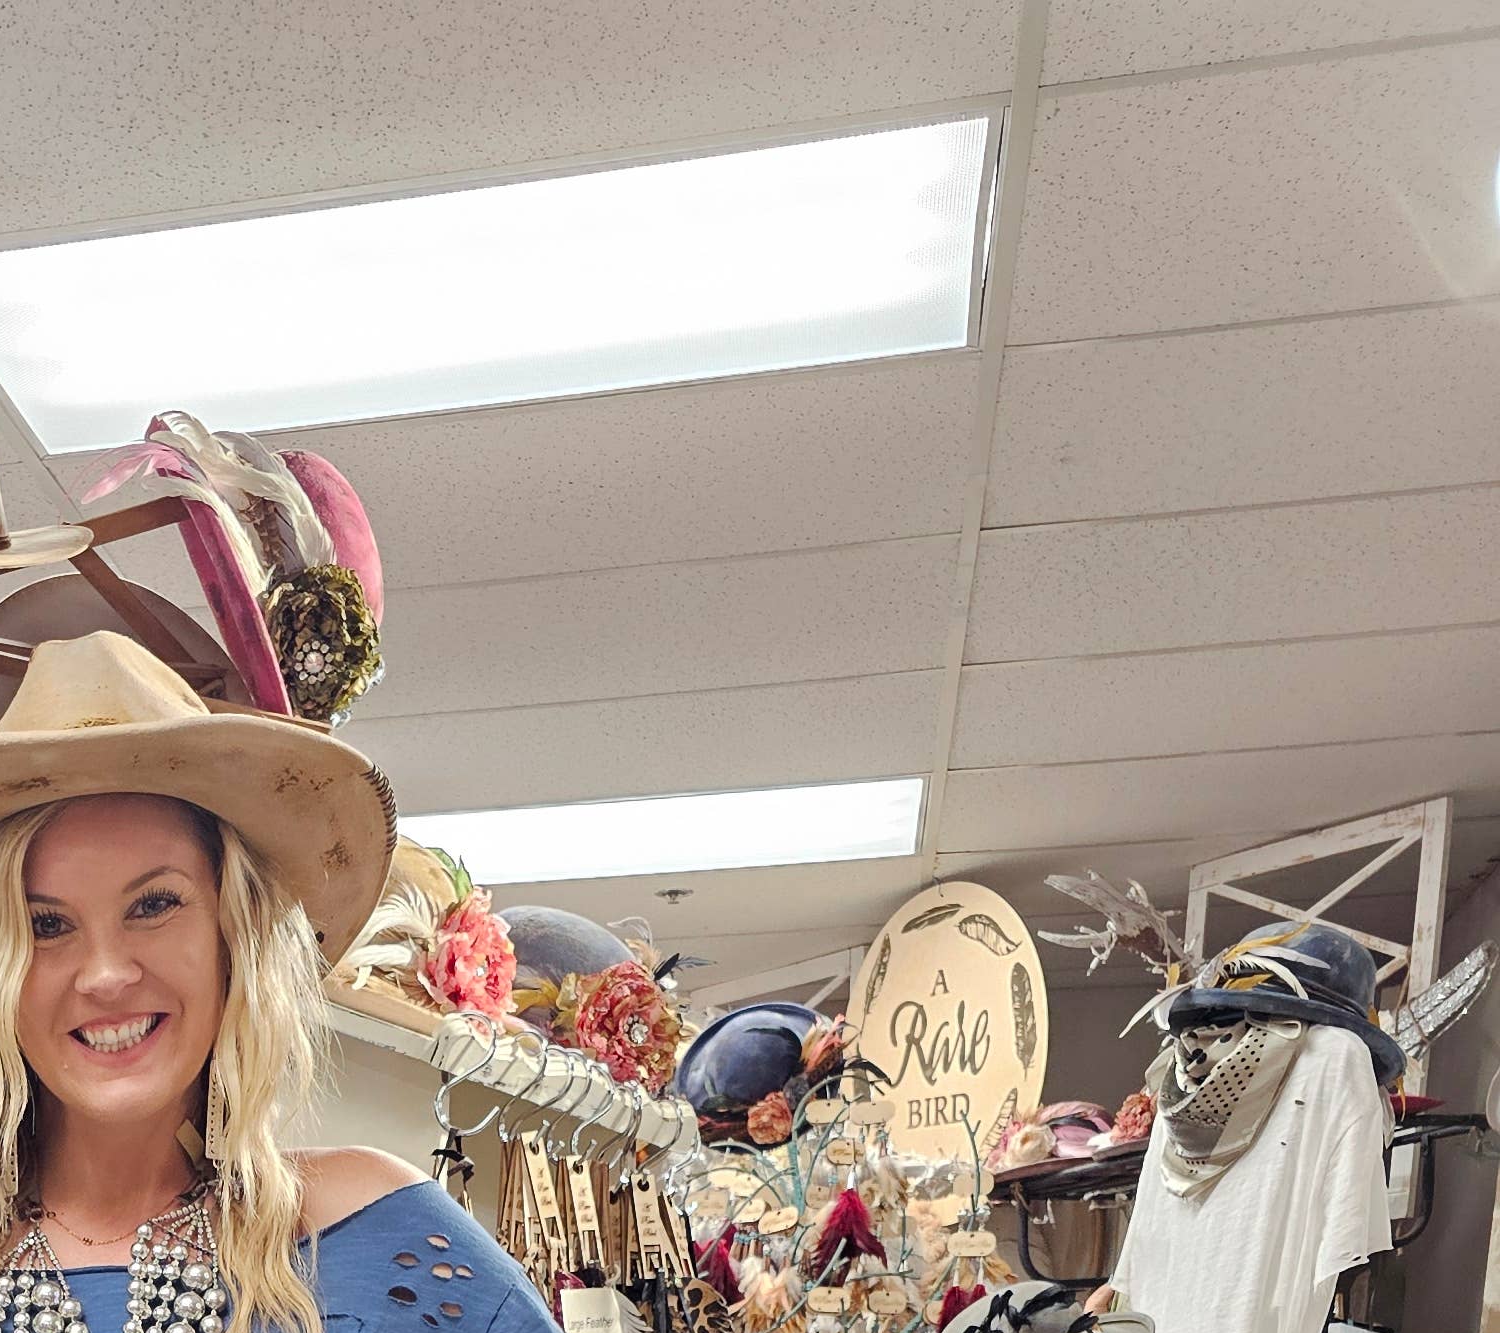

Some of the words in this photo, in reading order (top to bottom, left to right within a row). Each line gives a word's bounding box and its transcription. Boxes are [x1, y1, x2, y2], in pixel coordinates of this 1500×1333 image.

[930, 969, 950, 997] A
[889, 1000, 991, 1088] Rare
[907, 1093, 970, 1129] BIRD
[586, 1316, 613, 1329] Feather
